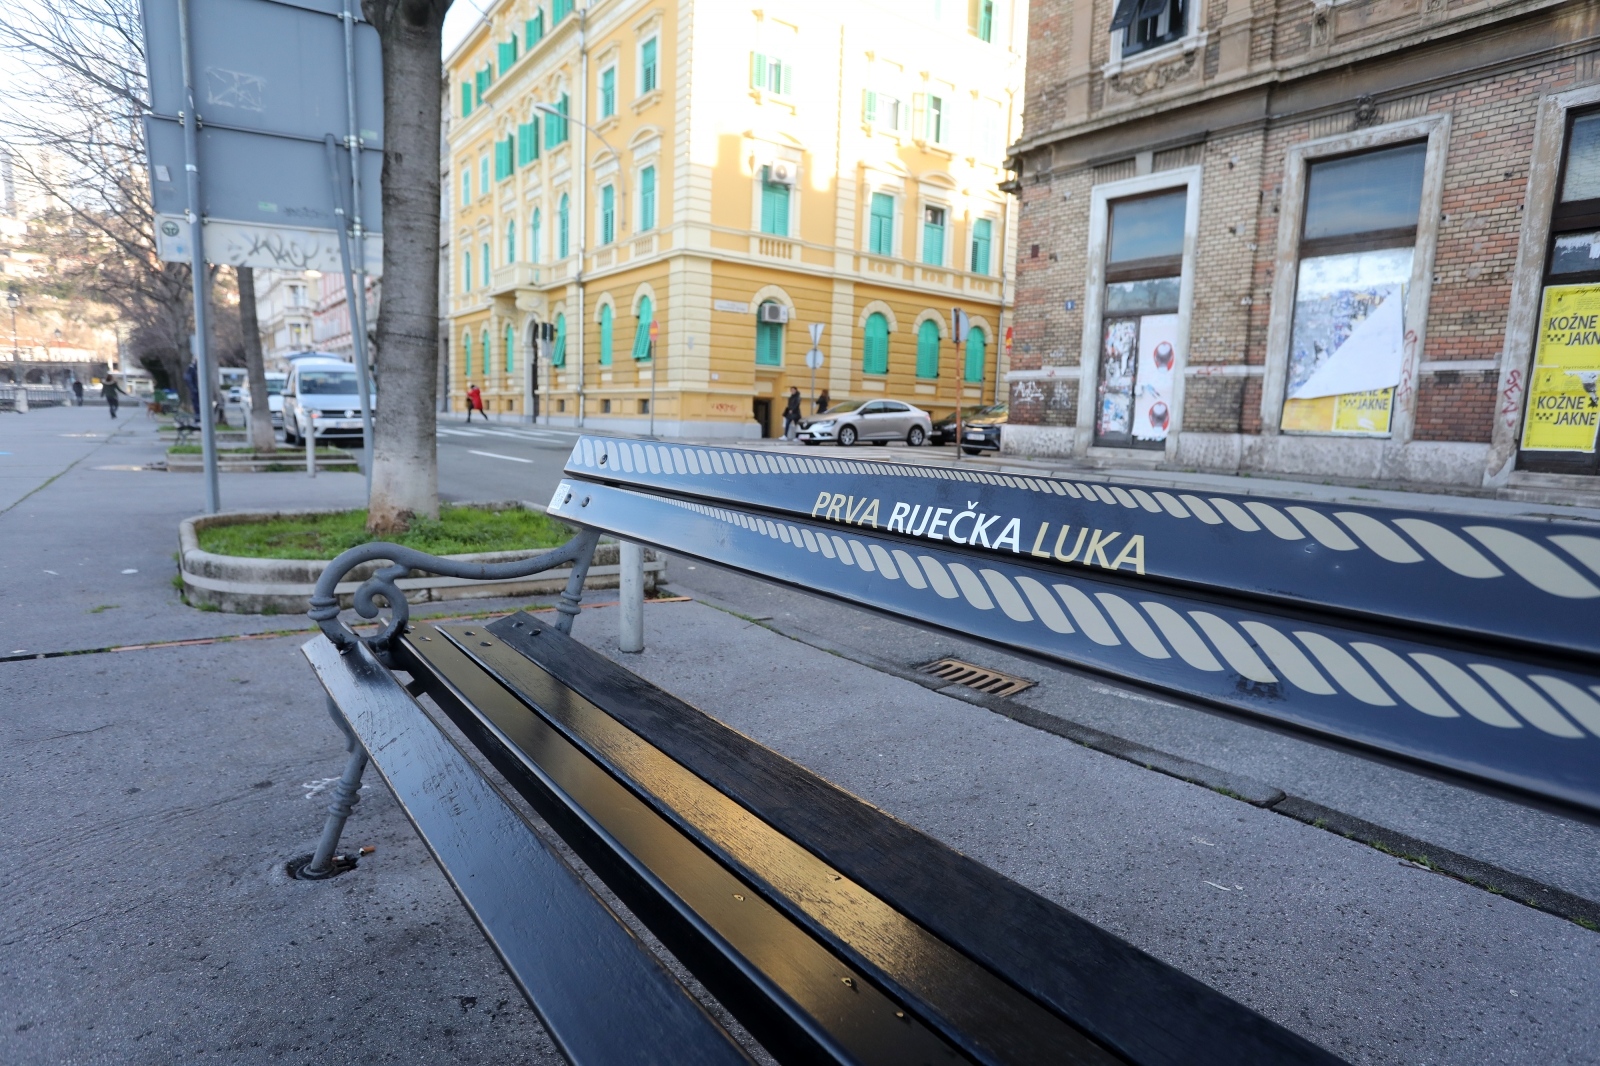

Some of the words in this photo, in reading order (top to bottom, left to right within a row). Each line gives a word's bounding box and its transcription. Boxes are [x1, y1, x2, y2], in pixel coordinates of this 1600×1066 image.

[1548, 312, 1598, 331] KOŽNE
[1357, 399, 1388, 410] JAKNE
[1537, 392, 1586, 410] KOŽNE
[1553, 411, 1597, 426] JAKNE
[811, 491, 880, 529] PRVA
[886, 500, 1022, 553] RIJEČKA
[1031, 521, 1146, 575] LUKA
